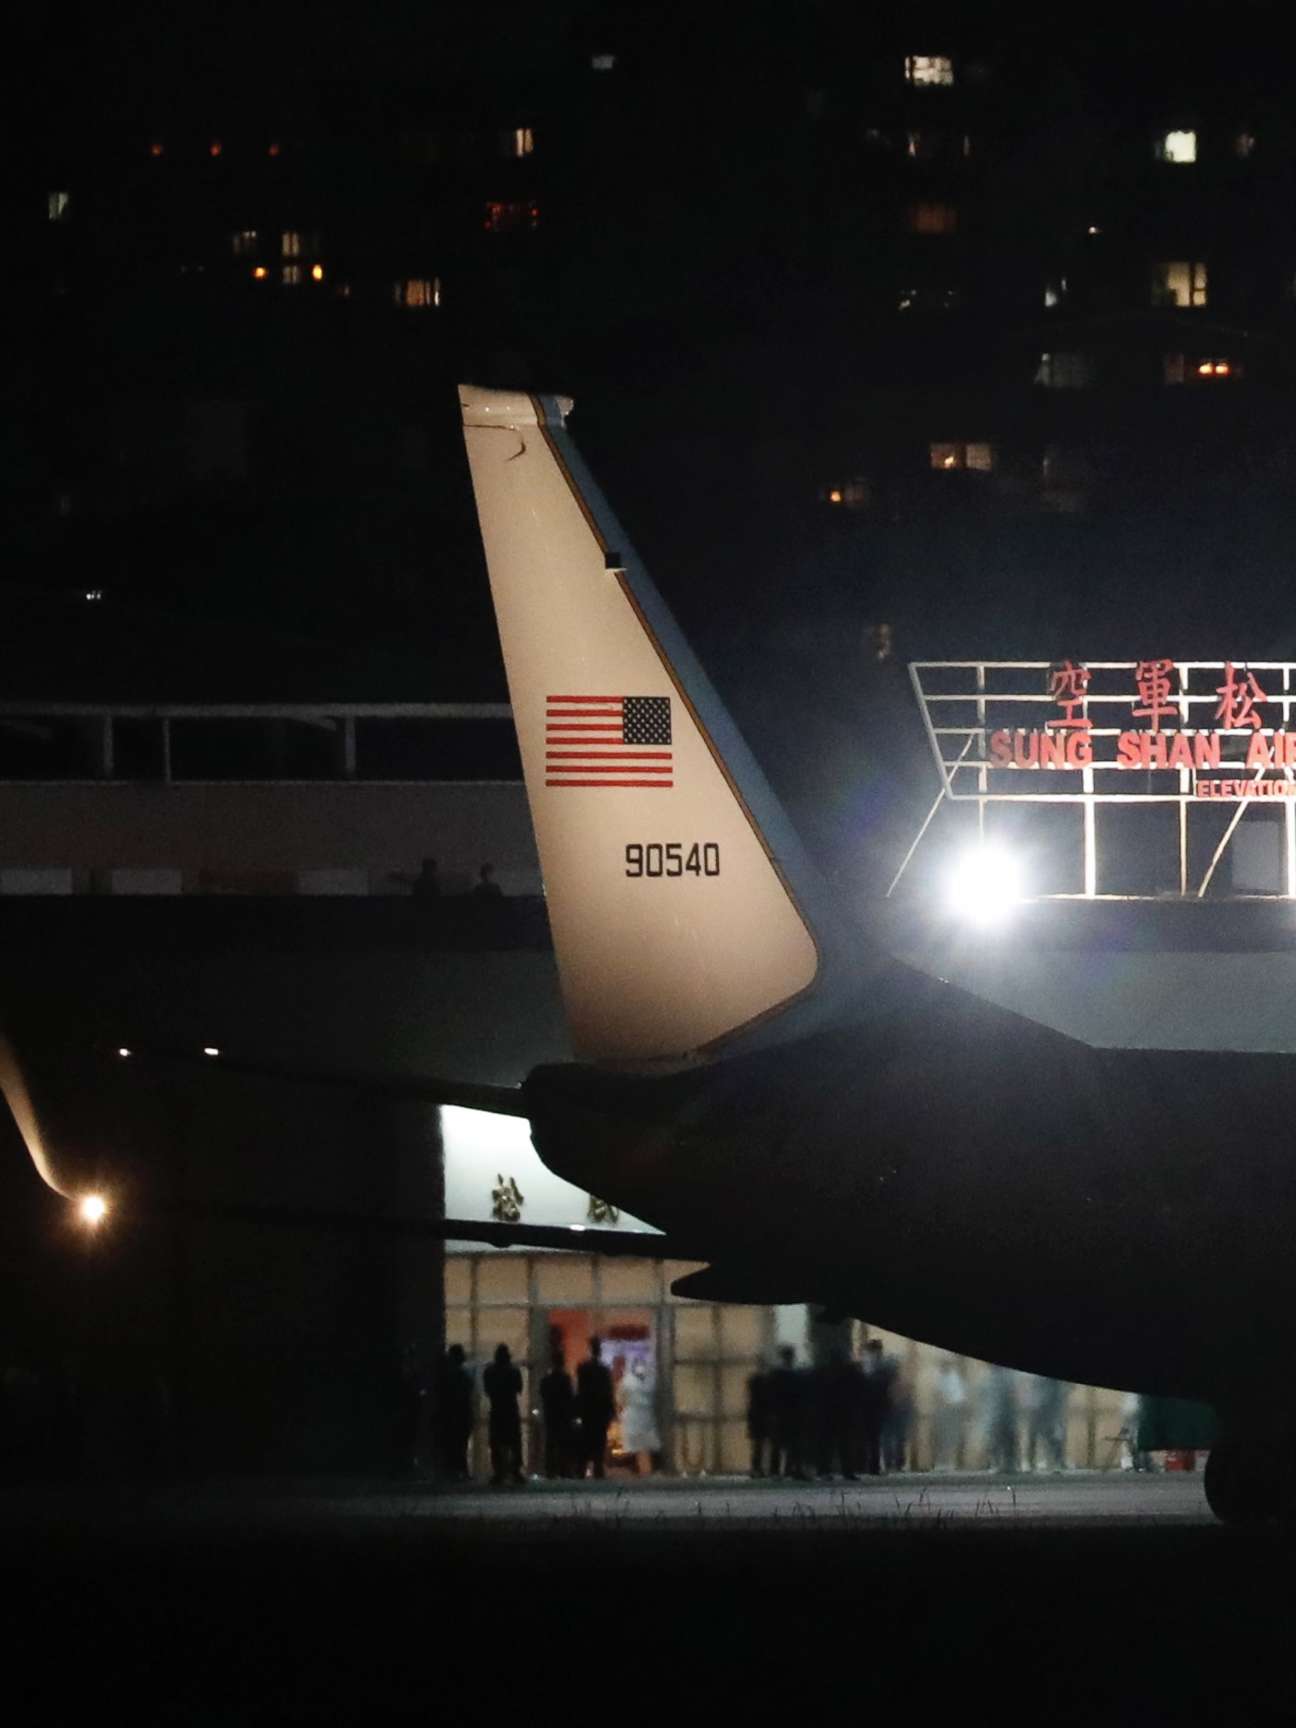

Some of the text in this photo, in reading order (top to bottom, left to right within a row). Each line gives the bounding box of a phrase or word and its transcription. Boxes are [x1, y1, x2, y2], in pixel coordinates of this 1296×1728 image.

[989, 729, 1093, 769] SUNG
[1117, 730, 1222, 769] SHAN
[625, 842, 720, 877] 90540
